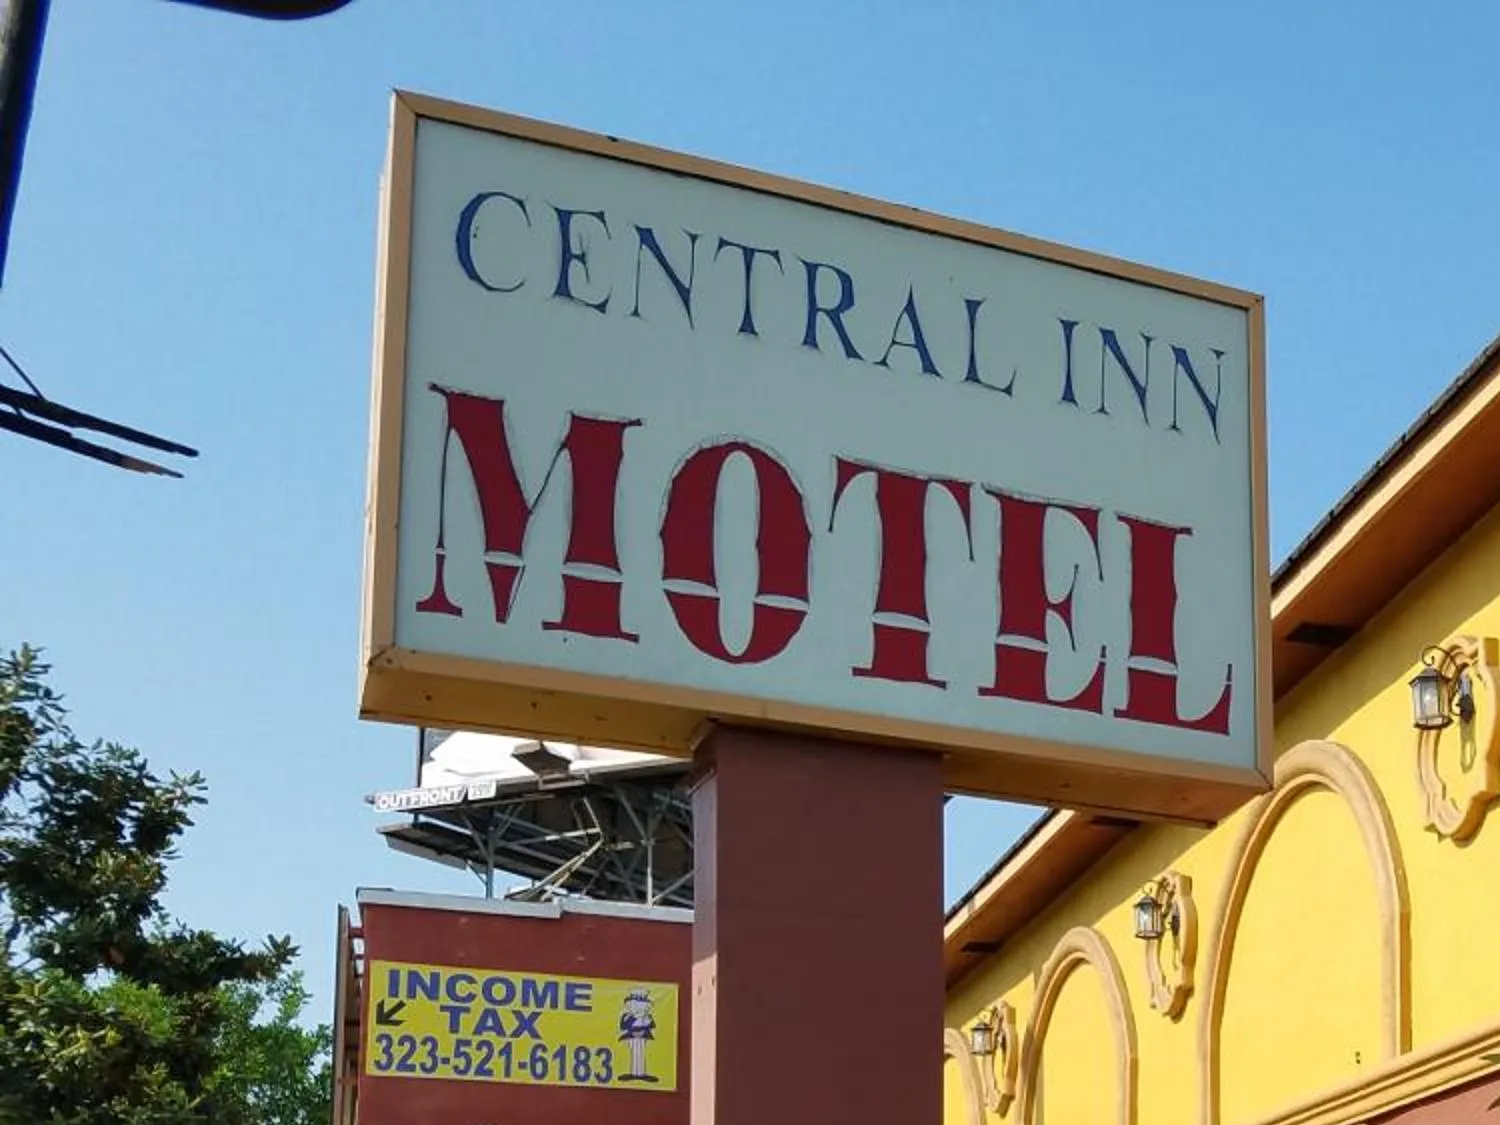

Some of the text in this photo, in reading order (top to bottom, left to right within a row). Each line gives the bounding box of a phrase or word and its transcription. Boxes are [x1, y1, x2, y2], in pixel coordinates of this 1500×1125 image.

[454, 190, 1228, 445] CENTRAL INN
[415, 381, 1234, 737] MOTEL
[386, 967, 594, 1012] INCOME
[439, 1004, 544, 1040] TAX
[373, 1033, 613, 1084] 323-521-6183
